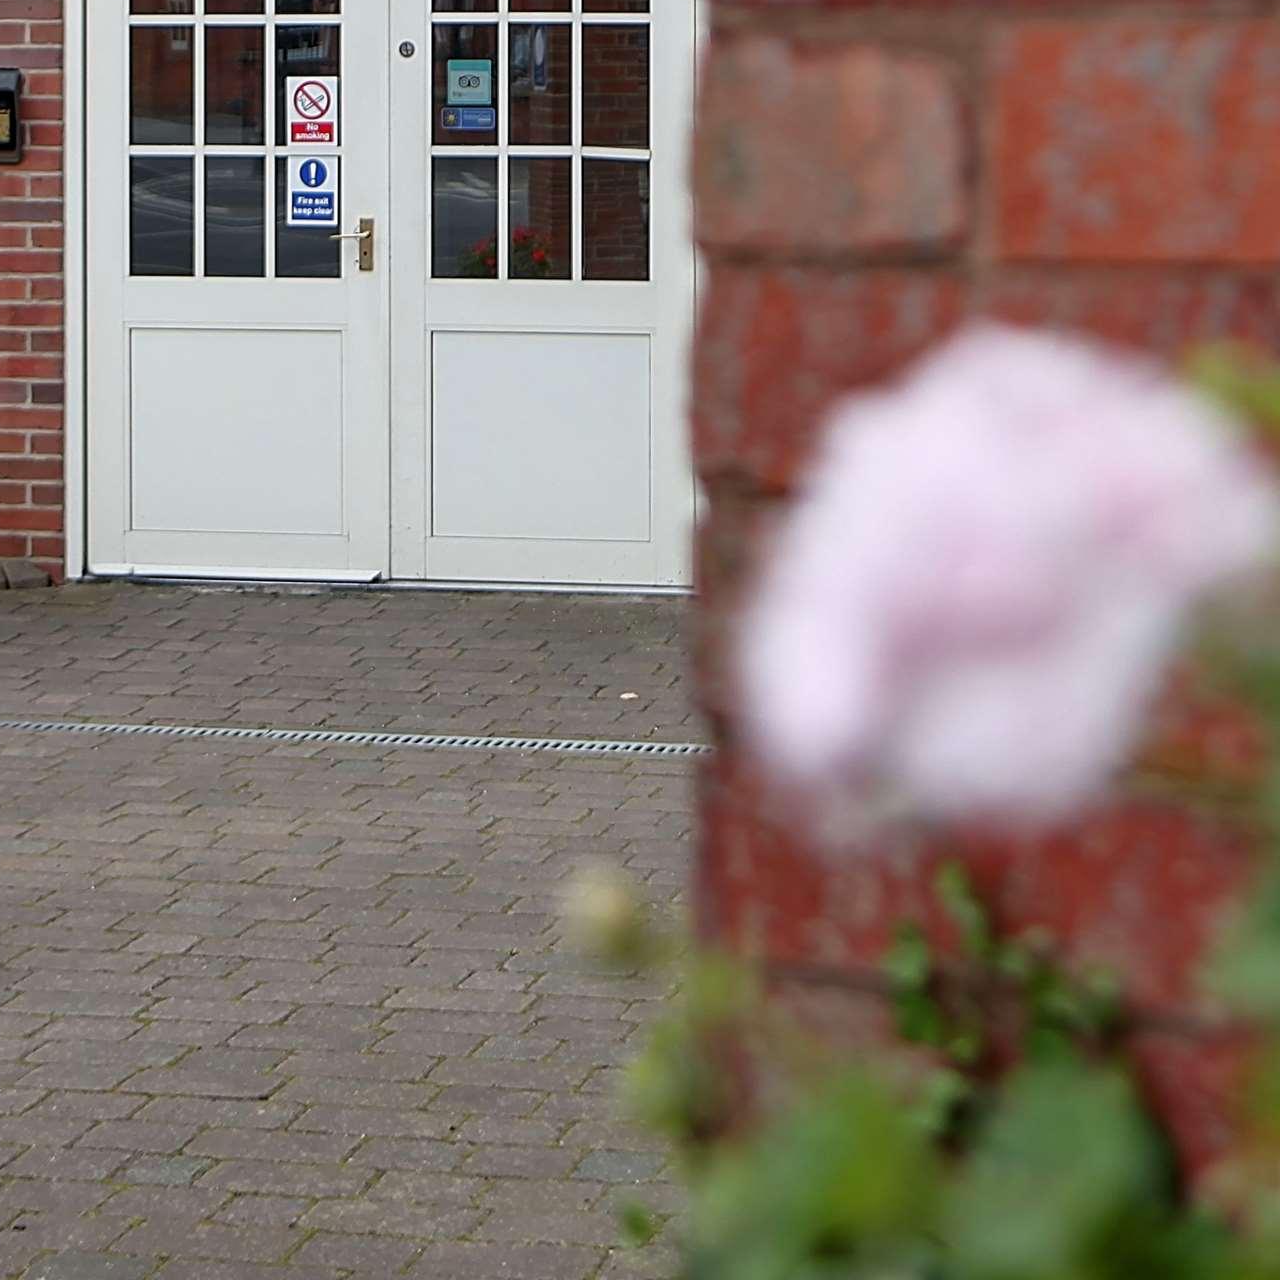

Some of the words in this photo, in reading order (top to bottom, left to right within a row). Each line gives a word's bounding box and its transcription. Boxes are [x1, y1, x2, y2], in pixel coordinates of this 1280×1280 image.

[306, 123, 319, 131] No
[294, 132, 330, 141] smoking
[297, 196, 313, 204] Fire
[314, 196, 329, 204] exit
[293, 207, 313, 216] keep
[314, 206, 333, 215] clear
